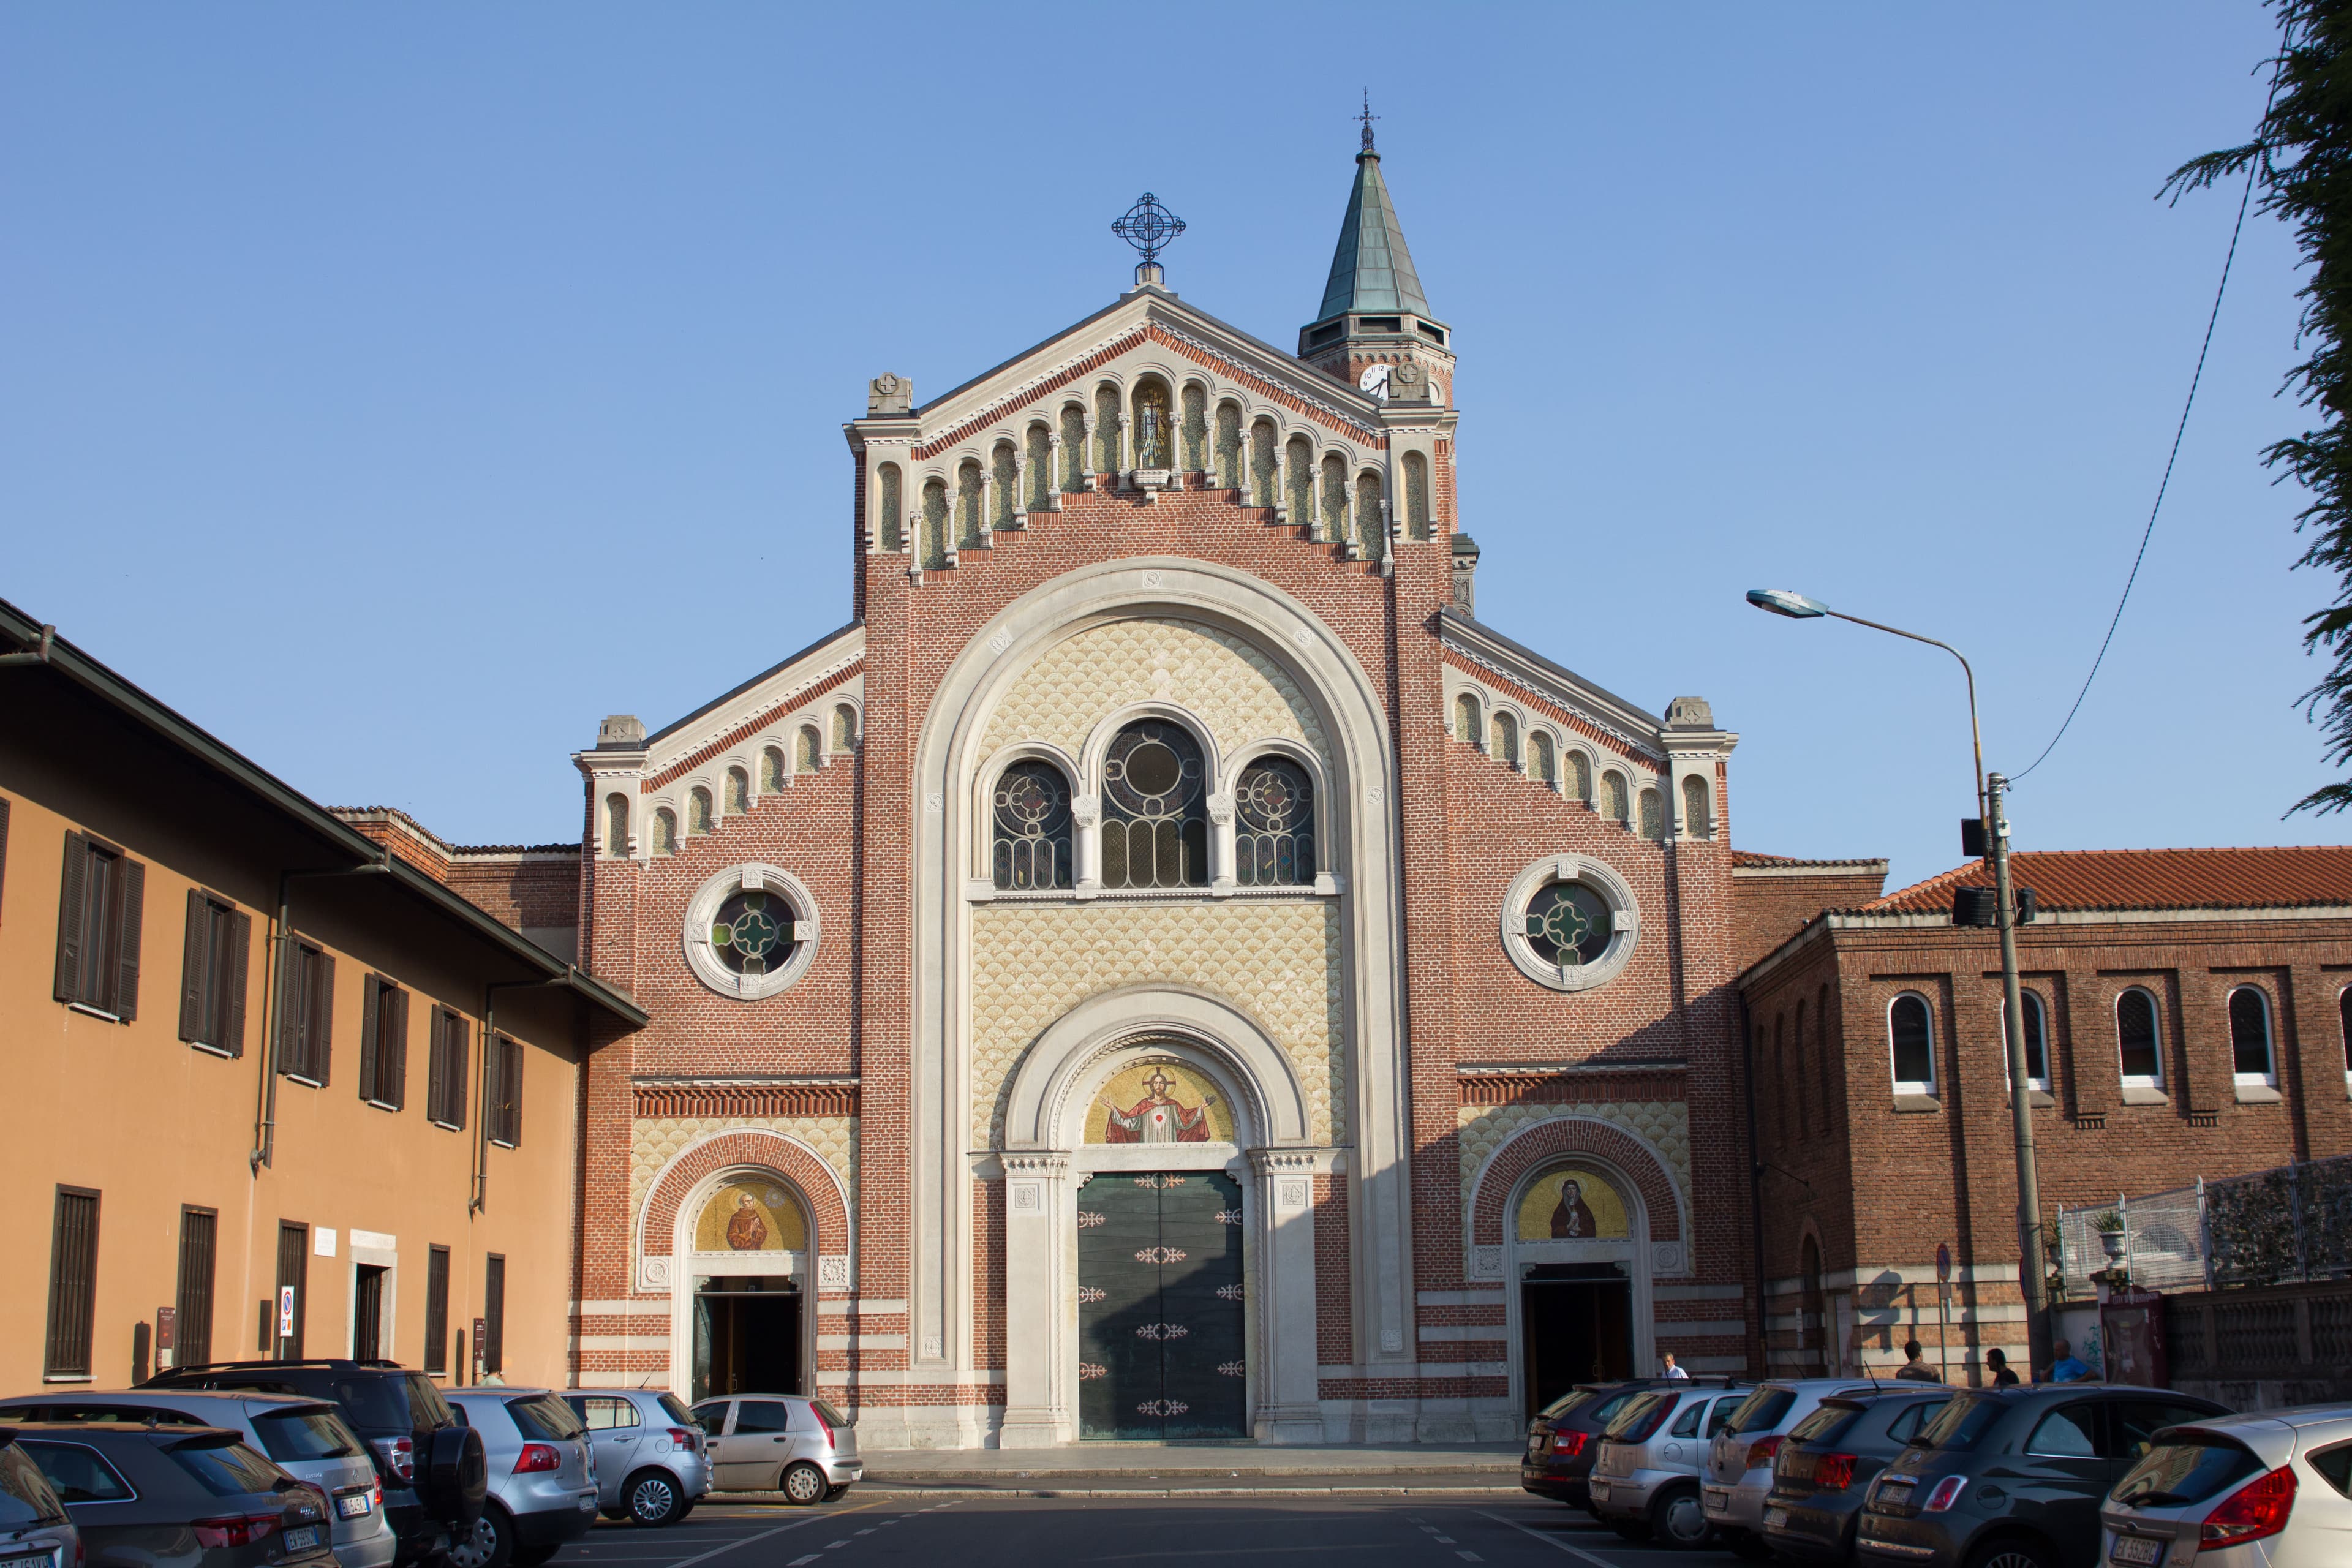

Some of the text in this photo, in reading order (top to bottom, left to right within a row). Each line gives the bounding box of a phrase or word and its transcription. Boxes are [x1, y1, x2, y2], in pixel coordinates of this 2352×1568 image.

[341, 1501, 350, 1514] EL
[2116, 1538, 2128, 1557] EK
[2128, 1540, 2156, 1562] 552BG
